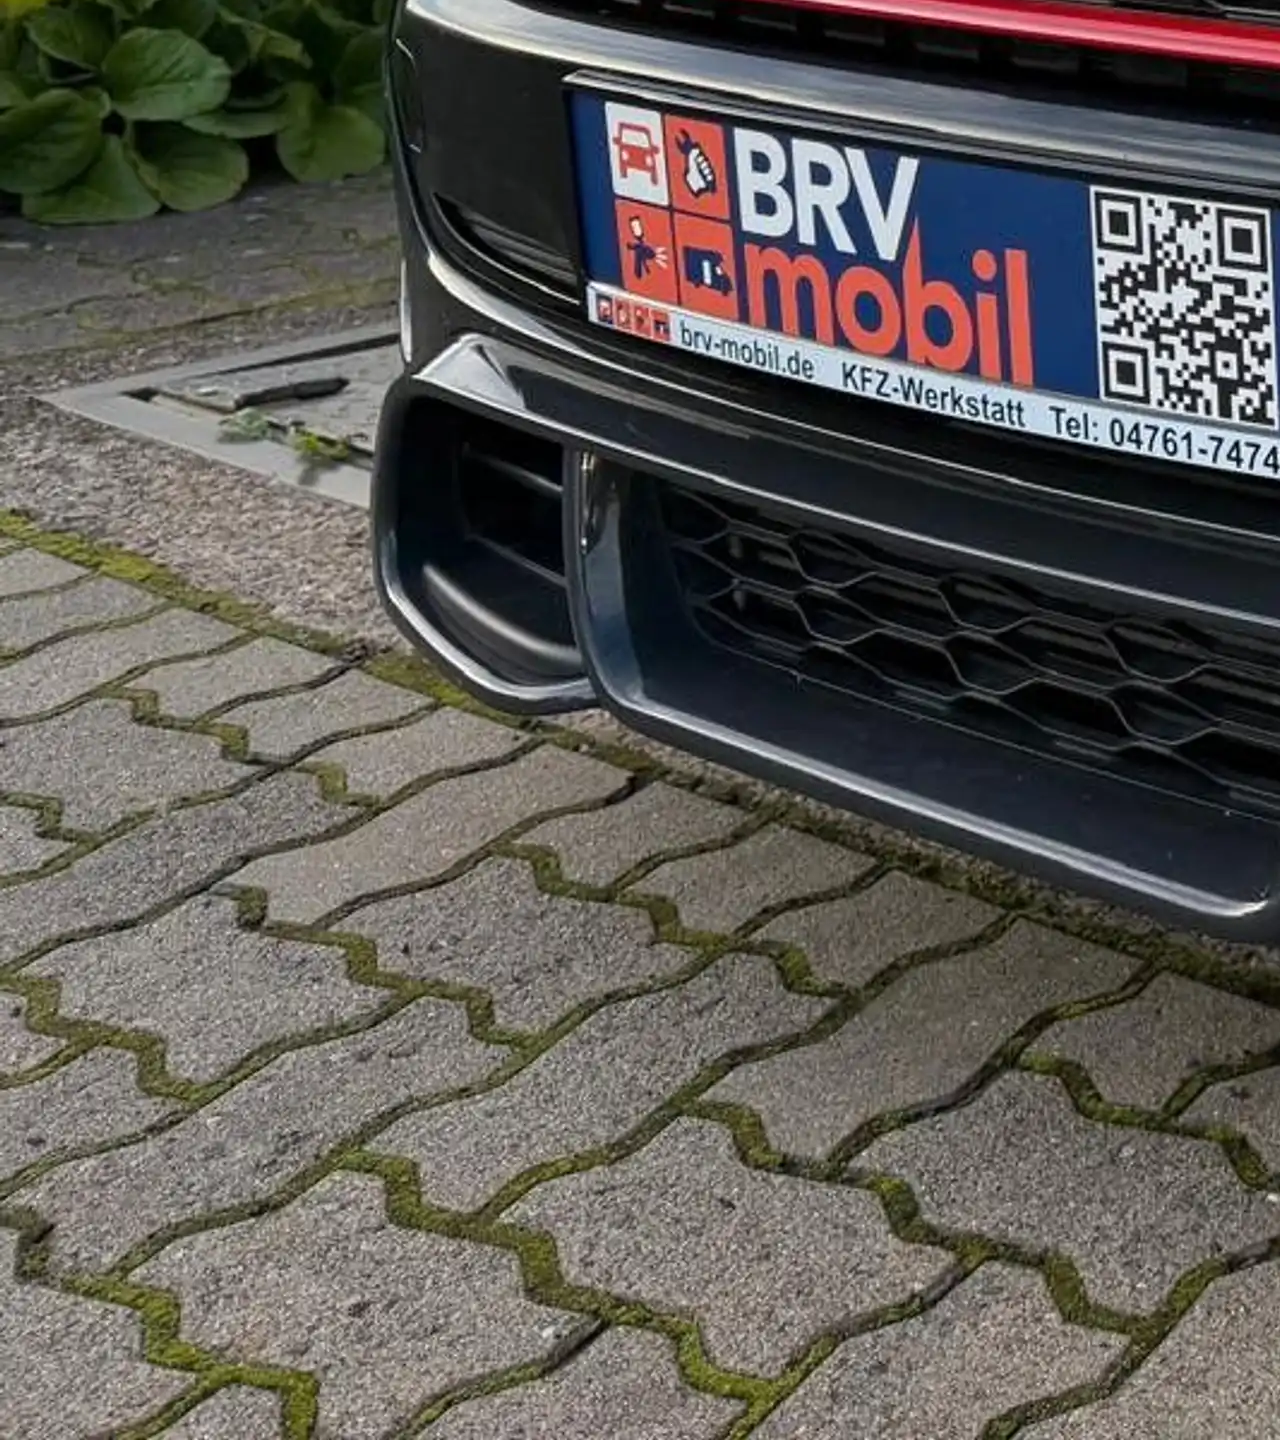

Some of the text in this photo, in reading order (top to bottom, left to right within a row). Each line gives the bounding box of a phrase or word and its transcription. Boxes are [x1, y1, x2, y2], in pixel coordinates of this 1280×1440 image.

[732, 127, 919, 262] BRV
[744, 216, 1034, 387] mobil
[680, 320, 815, 380] brv-mobil.de
[841, 362, 1026, 428] KFZ-Werkstatt
[1049, 405, 1099, 443] Tel:
